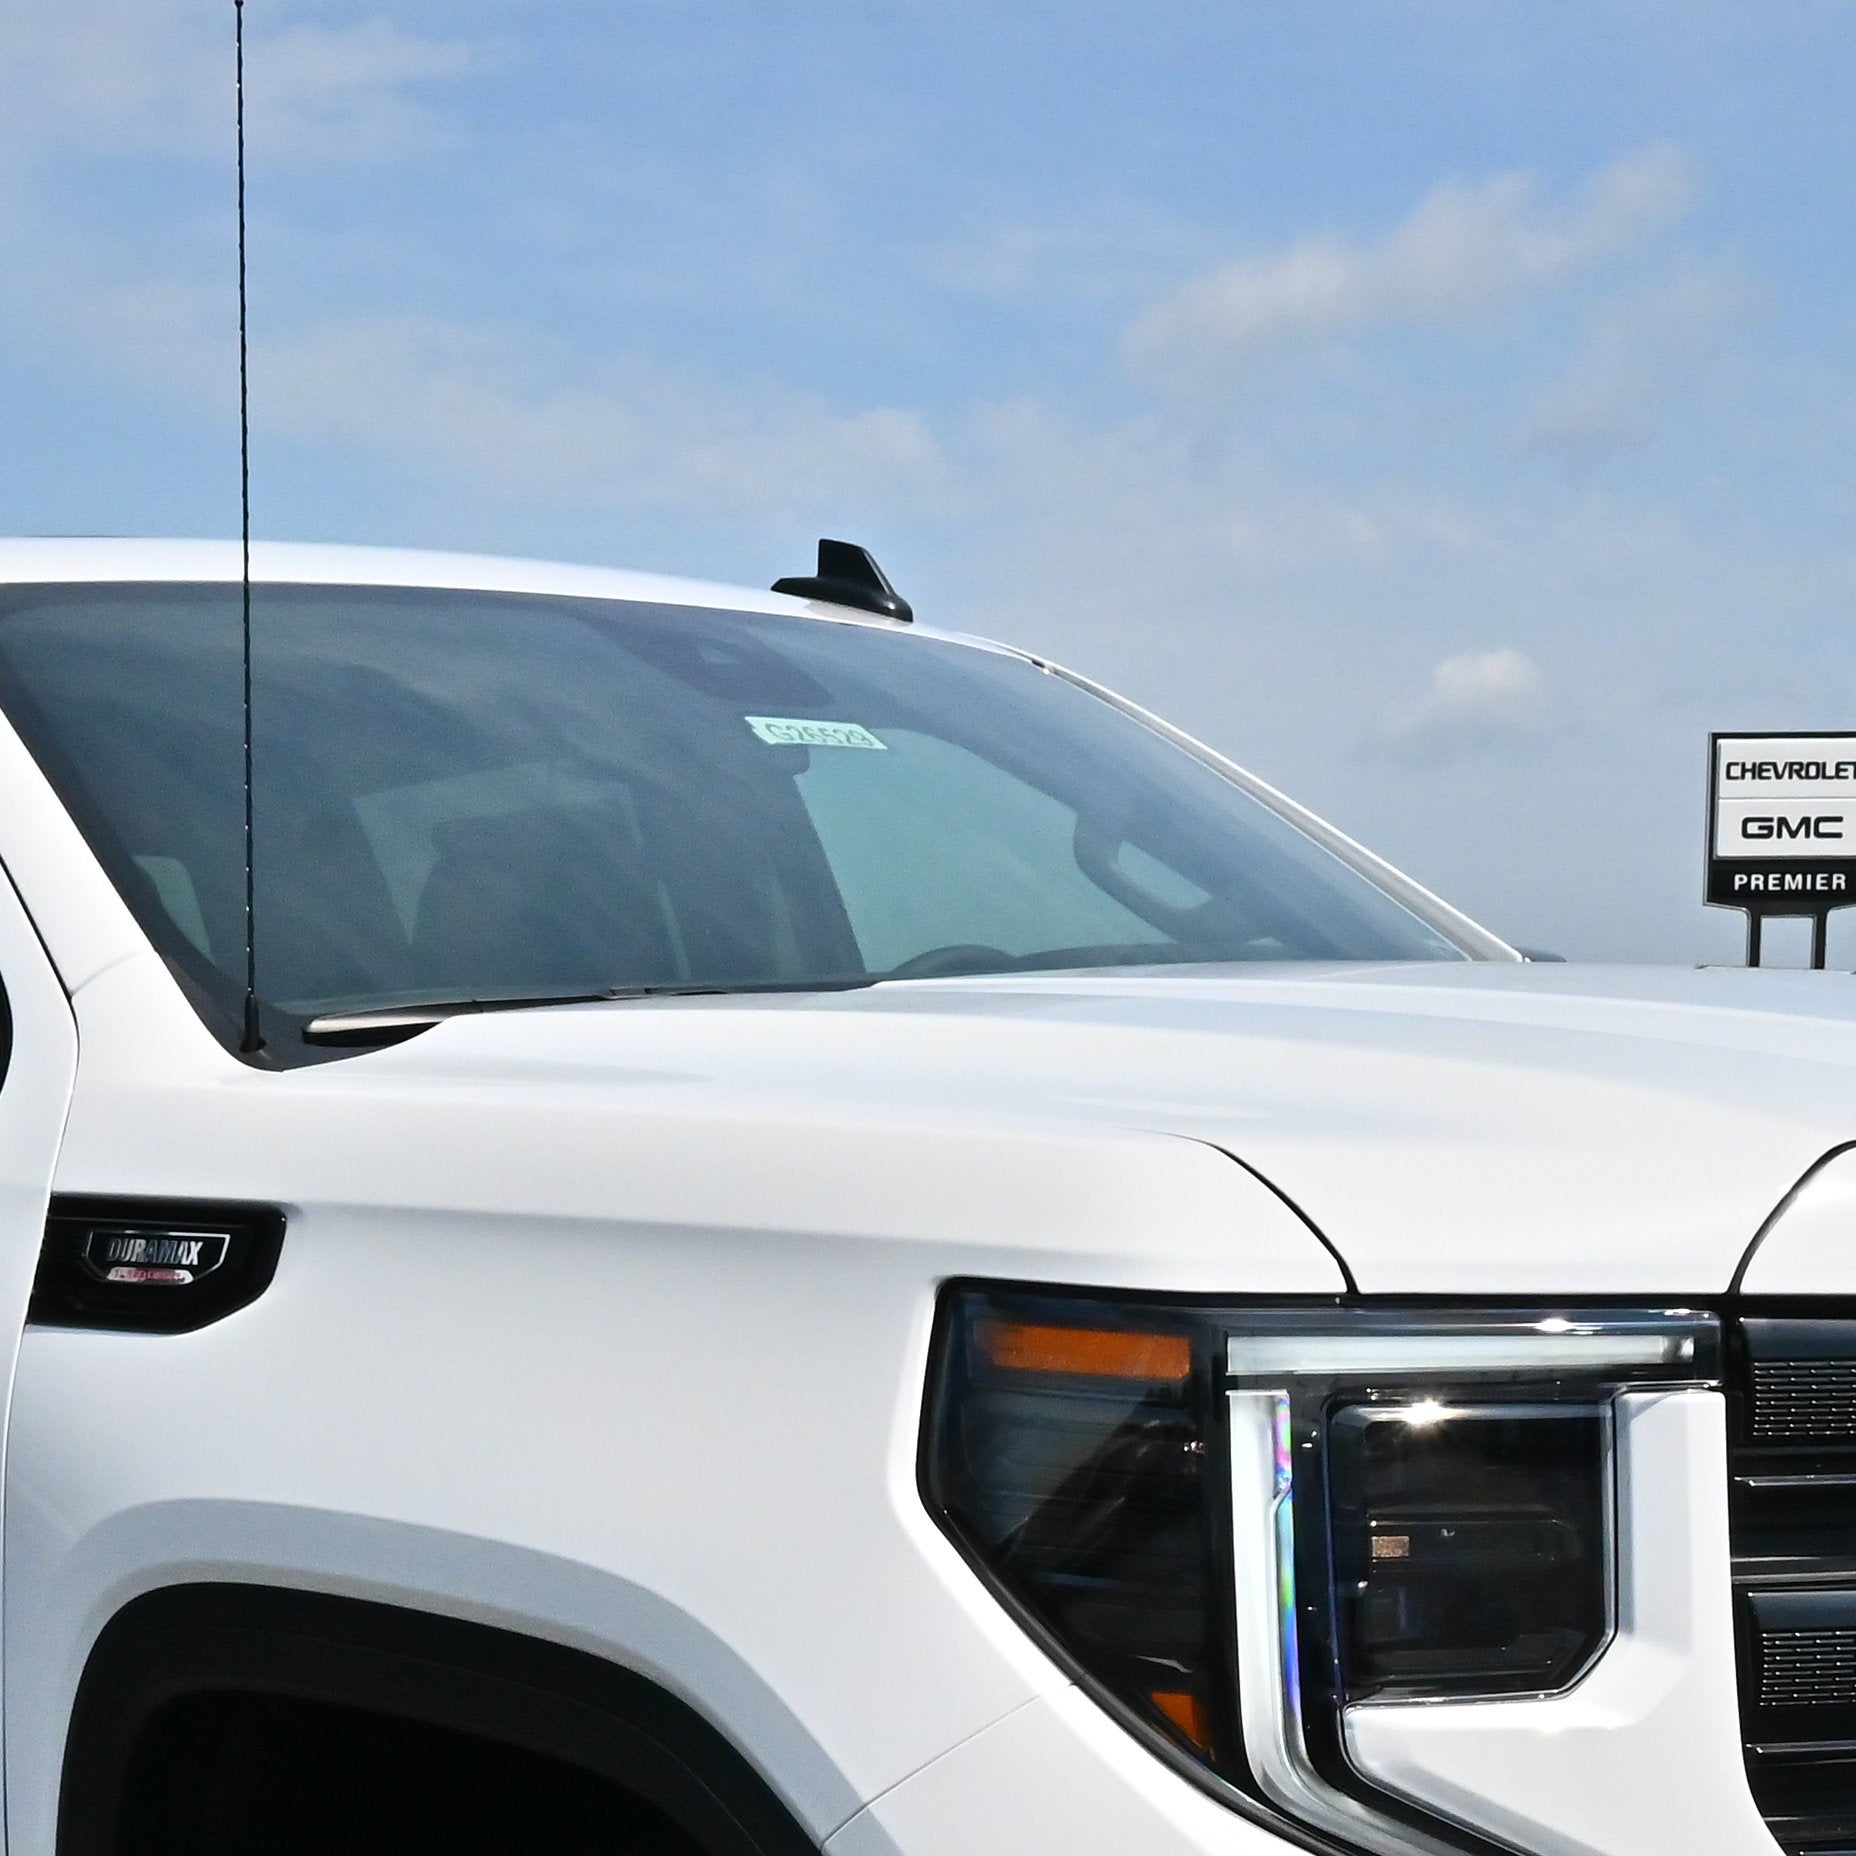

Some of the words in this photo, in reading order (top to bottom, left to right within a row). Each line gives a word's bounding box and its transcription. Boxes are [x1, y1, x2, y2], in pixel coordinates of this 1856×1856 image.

[1741, 816, 1844, 839] GMC
[1734, 873, 1847, 891] PREMIER
[106, 1238, 204, 1266] DURAMAX
